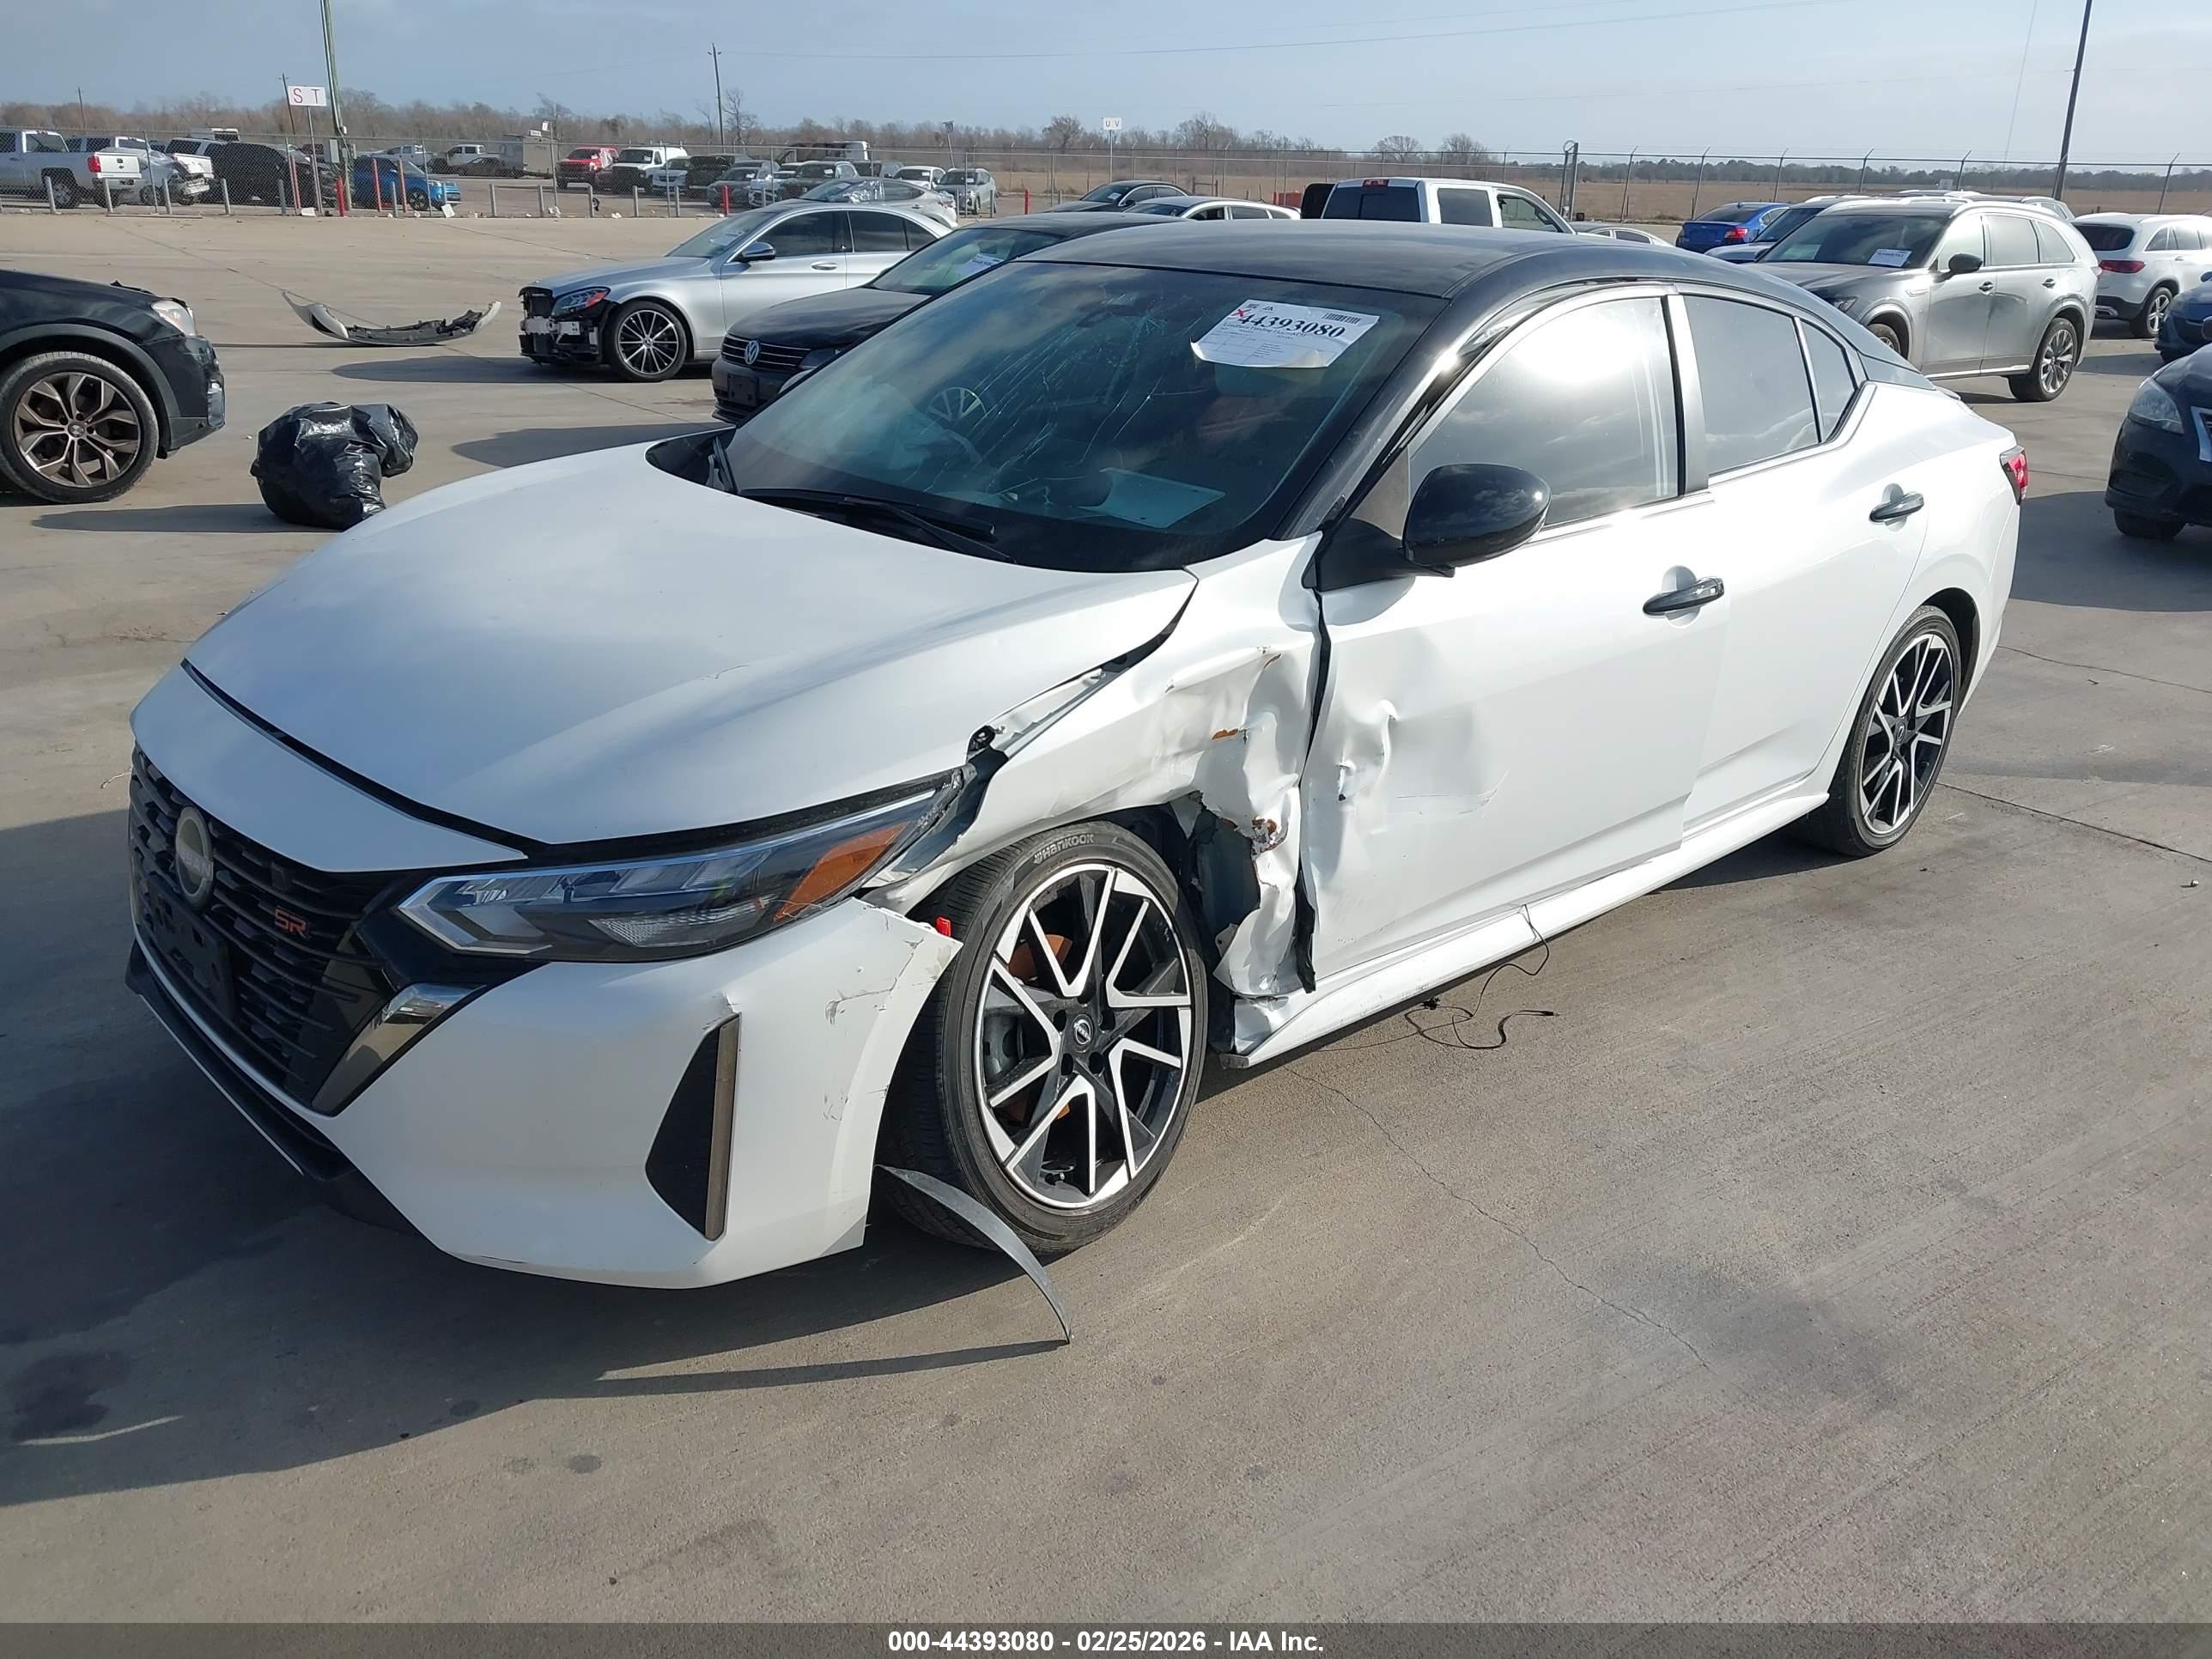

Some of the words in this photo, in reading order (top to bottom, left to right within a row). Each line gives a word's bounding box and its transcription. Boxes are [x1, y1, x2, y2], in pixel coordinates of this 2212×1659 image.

[293, 88, 303, 104] S
[311, 88, 320, 104] T
[1239, 313, 1346, 337] 44393080
[274, 906, 307, 939] SR
